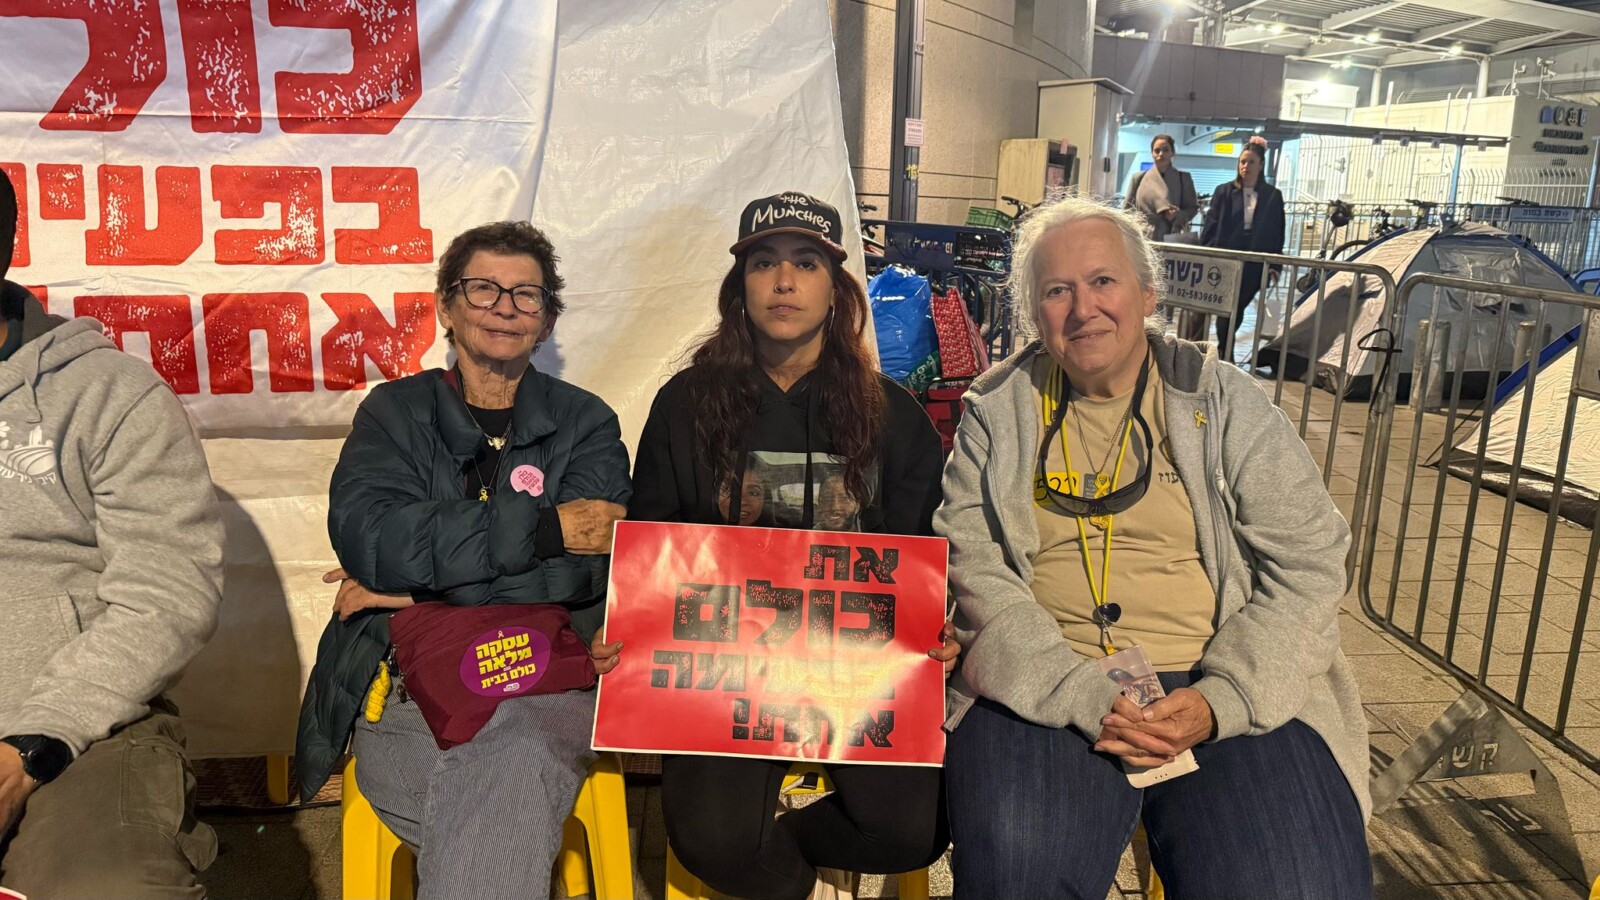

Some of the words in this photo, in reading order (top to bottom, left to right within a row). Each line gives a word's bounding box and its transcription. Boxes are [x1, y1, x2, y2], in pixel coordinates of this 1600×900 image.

[22, 285, 436, 394] אחת
[804, 544, 899, 584] את
[673, 579, 896, 648] כולם
[475, 633, 530, 660] עסקה
[478, 646, 533, 675] מלאה
[480, 672, 509, 689] בבית
[509, 663, 537, 680] כולם
[1438, 742, 1499, 770] קש
